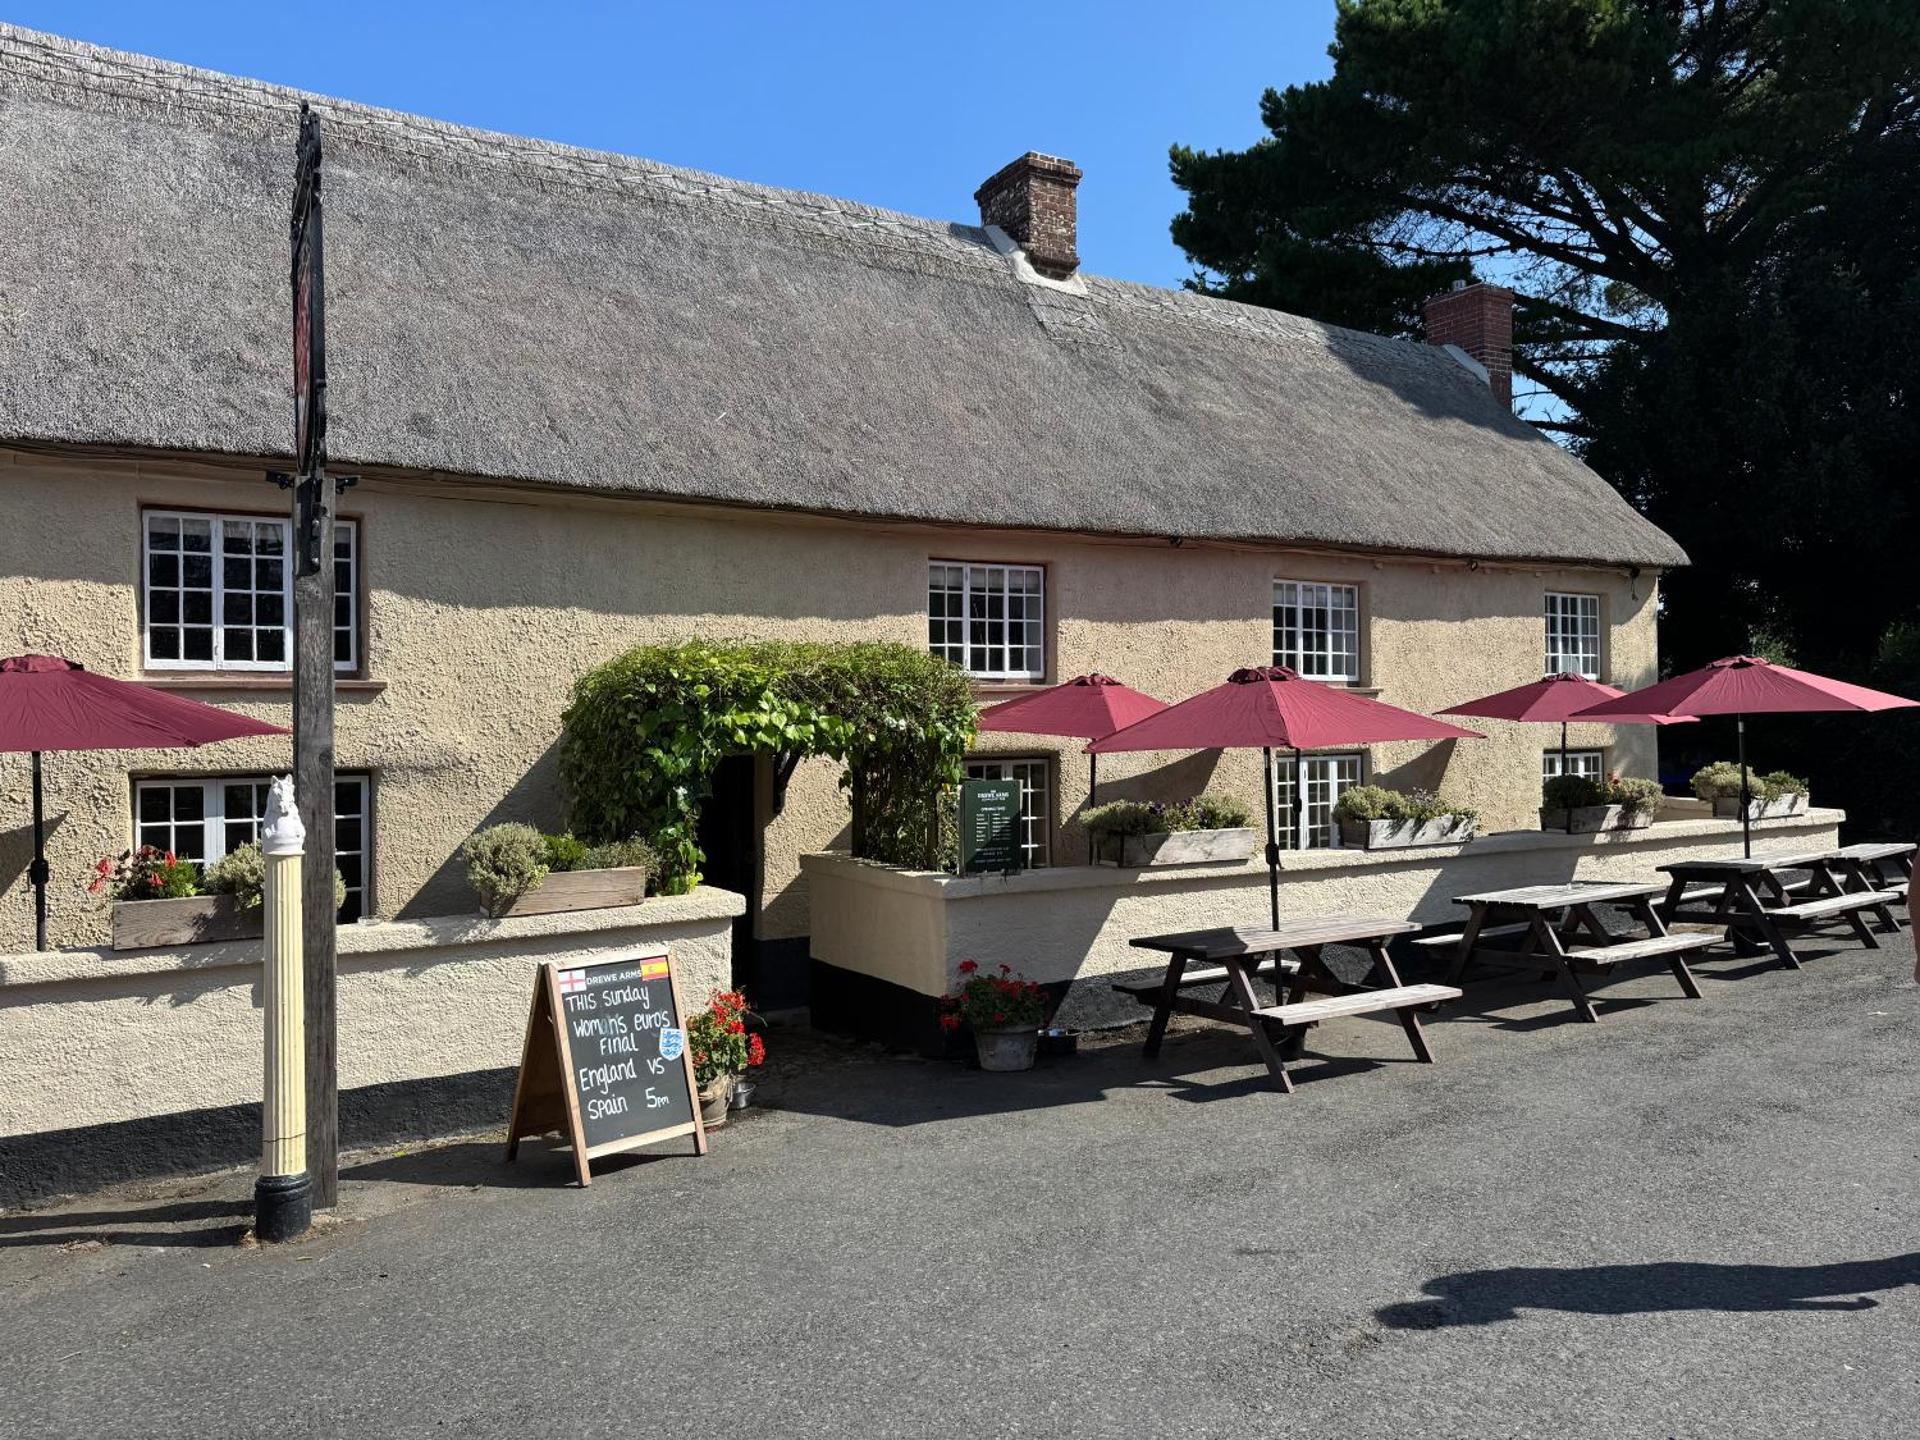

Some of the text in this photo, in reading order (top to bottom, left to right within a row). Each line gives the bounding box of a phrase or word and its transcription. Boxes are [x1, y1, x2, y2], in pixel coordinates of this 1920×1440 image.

[586, 969, 642, 985] DREWE ARMS
[565, 993, 597, 1012] THIS
[579, 1058, 638, 1095] England
[587, 1087, 670, 1120] Spain 5pm
